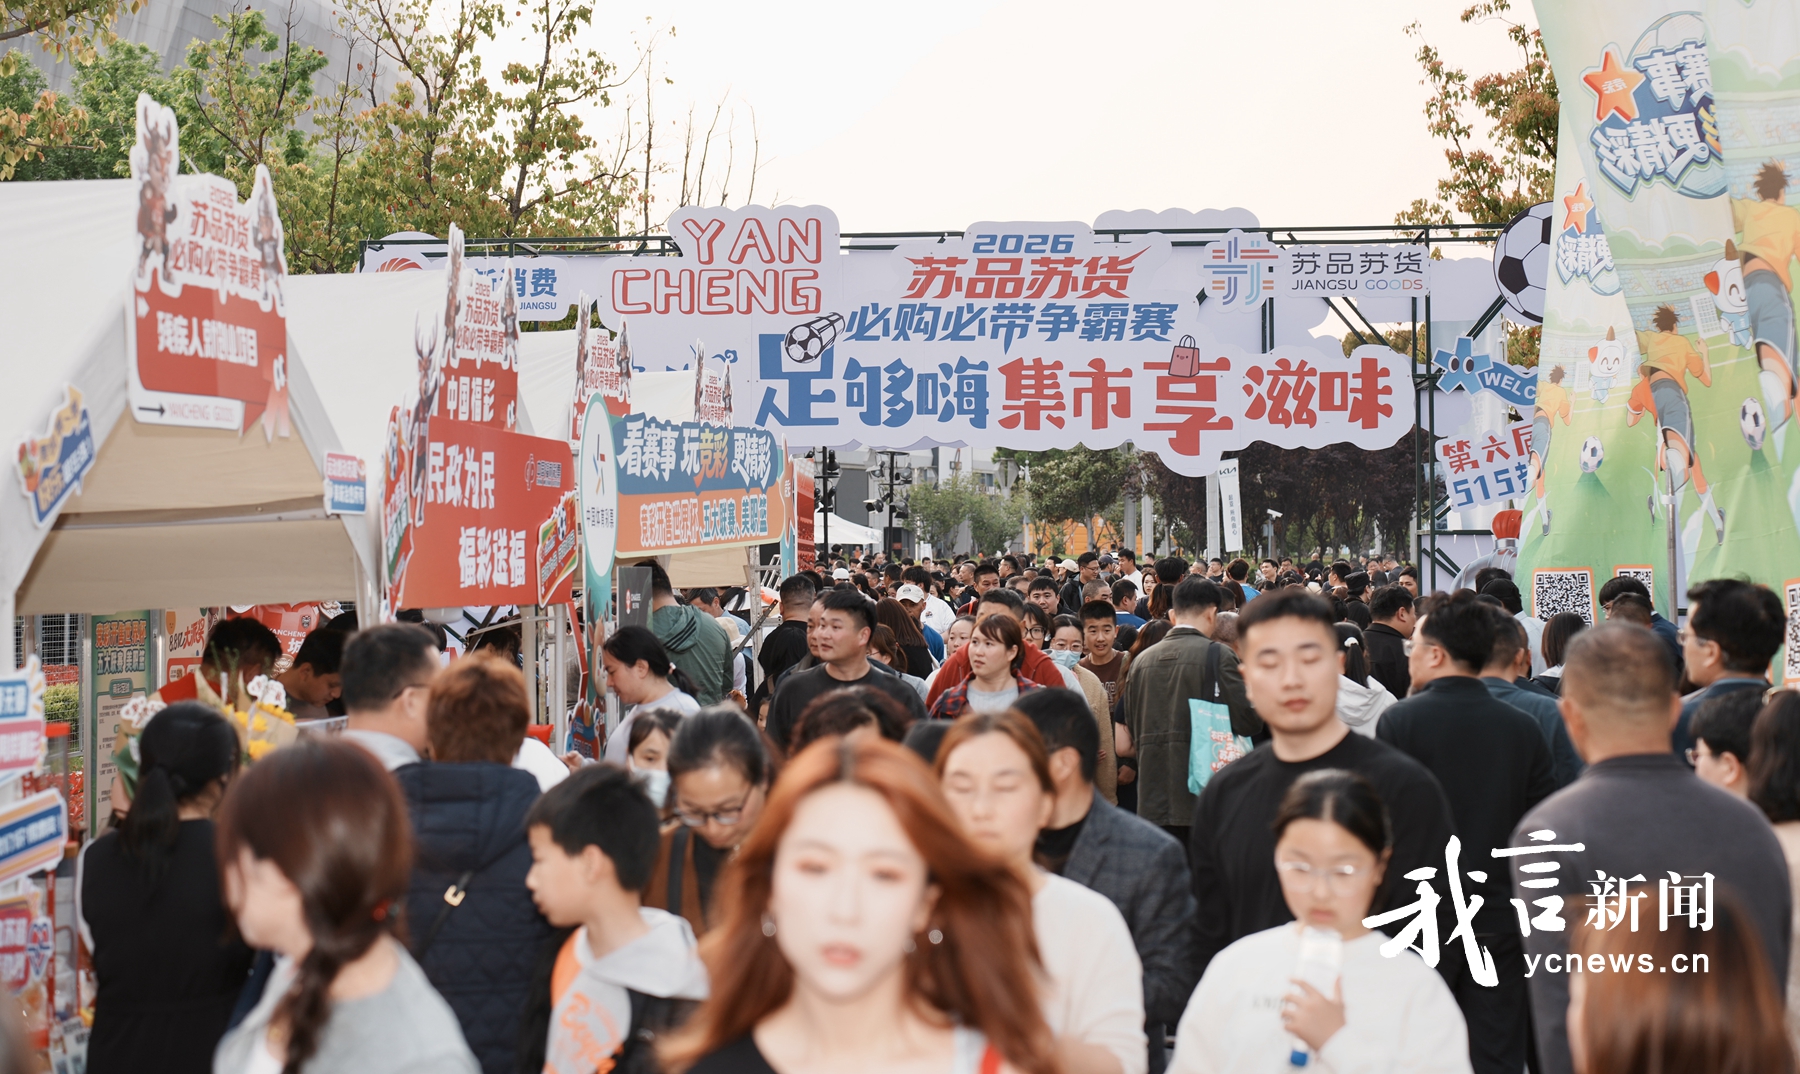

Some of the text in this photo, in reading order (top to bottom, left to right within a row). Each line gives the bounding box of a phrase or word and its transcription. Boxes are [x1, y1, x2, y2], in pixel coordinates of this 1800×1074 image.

[191, 200, 249, 252] 苏品苏货
[681, 217, 822, 265] YAN
[971, 234, 1075, 254] 2026
[170, 237, 262, 291] 必购必带争霸赛
[900, 245, 1152, 299] 苏品苏货
[1291, 251, 1424, 276] 苏品苏货
[475, 282, 490, 298] 2026
[611, 268, 822, 316] CHENG
[1291, 278, 1424, 291] JIANGSU GOODS
[465, 296, 499, 327] 苏品苏货
[519, 301, 557, 311] JIANGSU
[455, 325, 505, 356] 必购必带争霸赛
[596, 335, 609, 346] 2026
[842, 302, 1179, 355] 必购必带争霸赛
[590, 345, 616, 370] 苏品苏货
[584, 369, 621, 392] 必购必带争霸赛
[704, 384, 722, 404] 苏品苏货
[755, 333, 1394, 457] 足够嗨集市享滋味
[446, 375, 495, 422] 中国福彩
[616, 418, 679, 482] 看赛事
[681, 427, 729, 489] 玩竞彩
[731, 431, 771, 489] 更精彩
[427, 442, 495, 509] 民政为民
[1219, 466, 1237, 476] KIA
[458, 526, 527, 589] 福彩送福
[96, 650, 124, 675] 五大联赛
